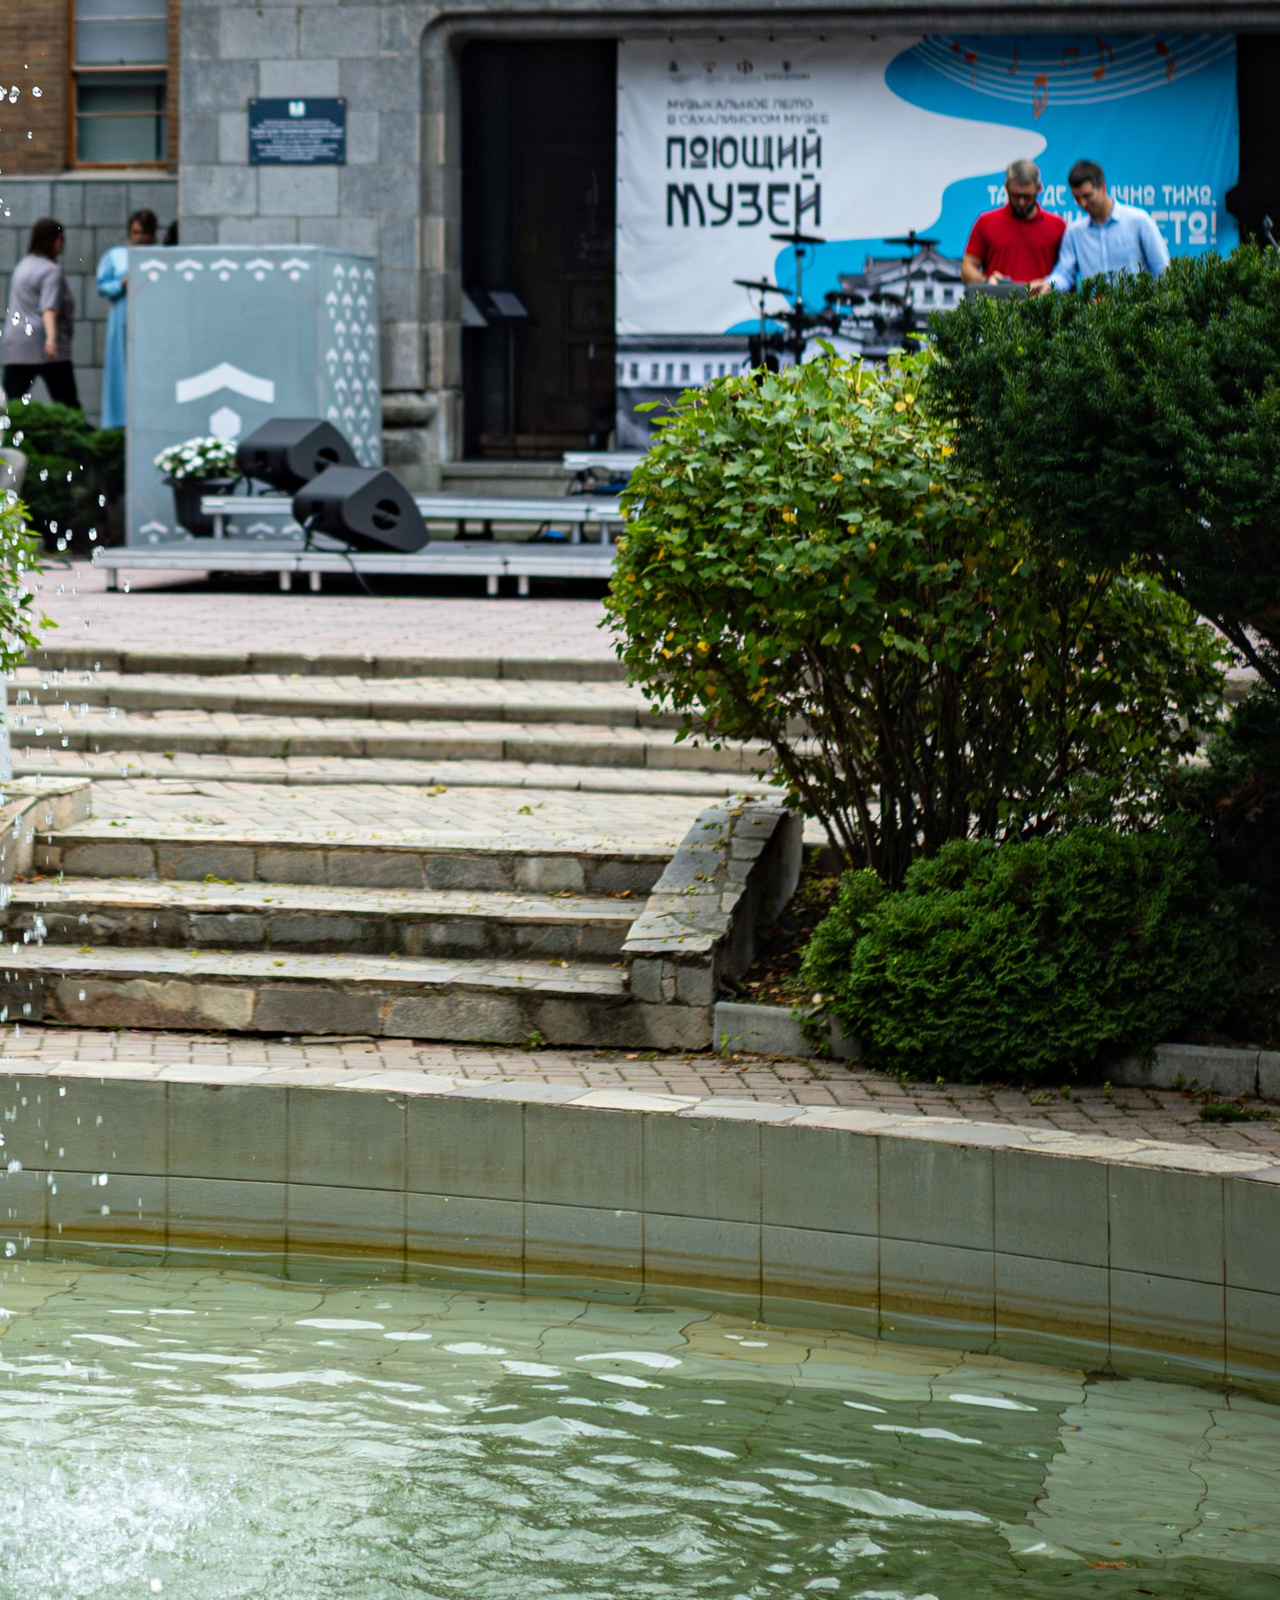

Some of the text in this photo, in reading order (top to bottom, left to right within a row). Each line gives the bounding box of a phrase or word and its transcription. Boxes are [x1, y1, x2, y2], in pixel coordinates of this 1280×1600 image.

[667, 114, 676, 126] В
[679, 114, 781, 125] САХАЛИНСКОМ
[667, 128, 822, 171] ПОЮЩИЙ
[667, 174, 822, 228] МУЗЕЙ
[1162, 184, 1217, 207] ТИХО,
[1151, 210, 1218, 245] ЕТО!
